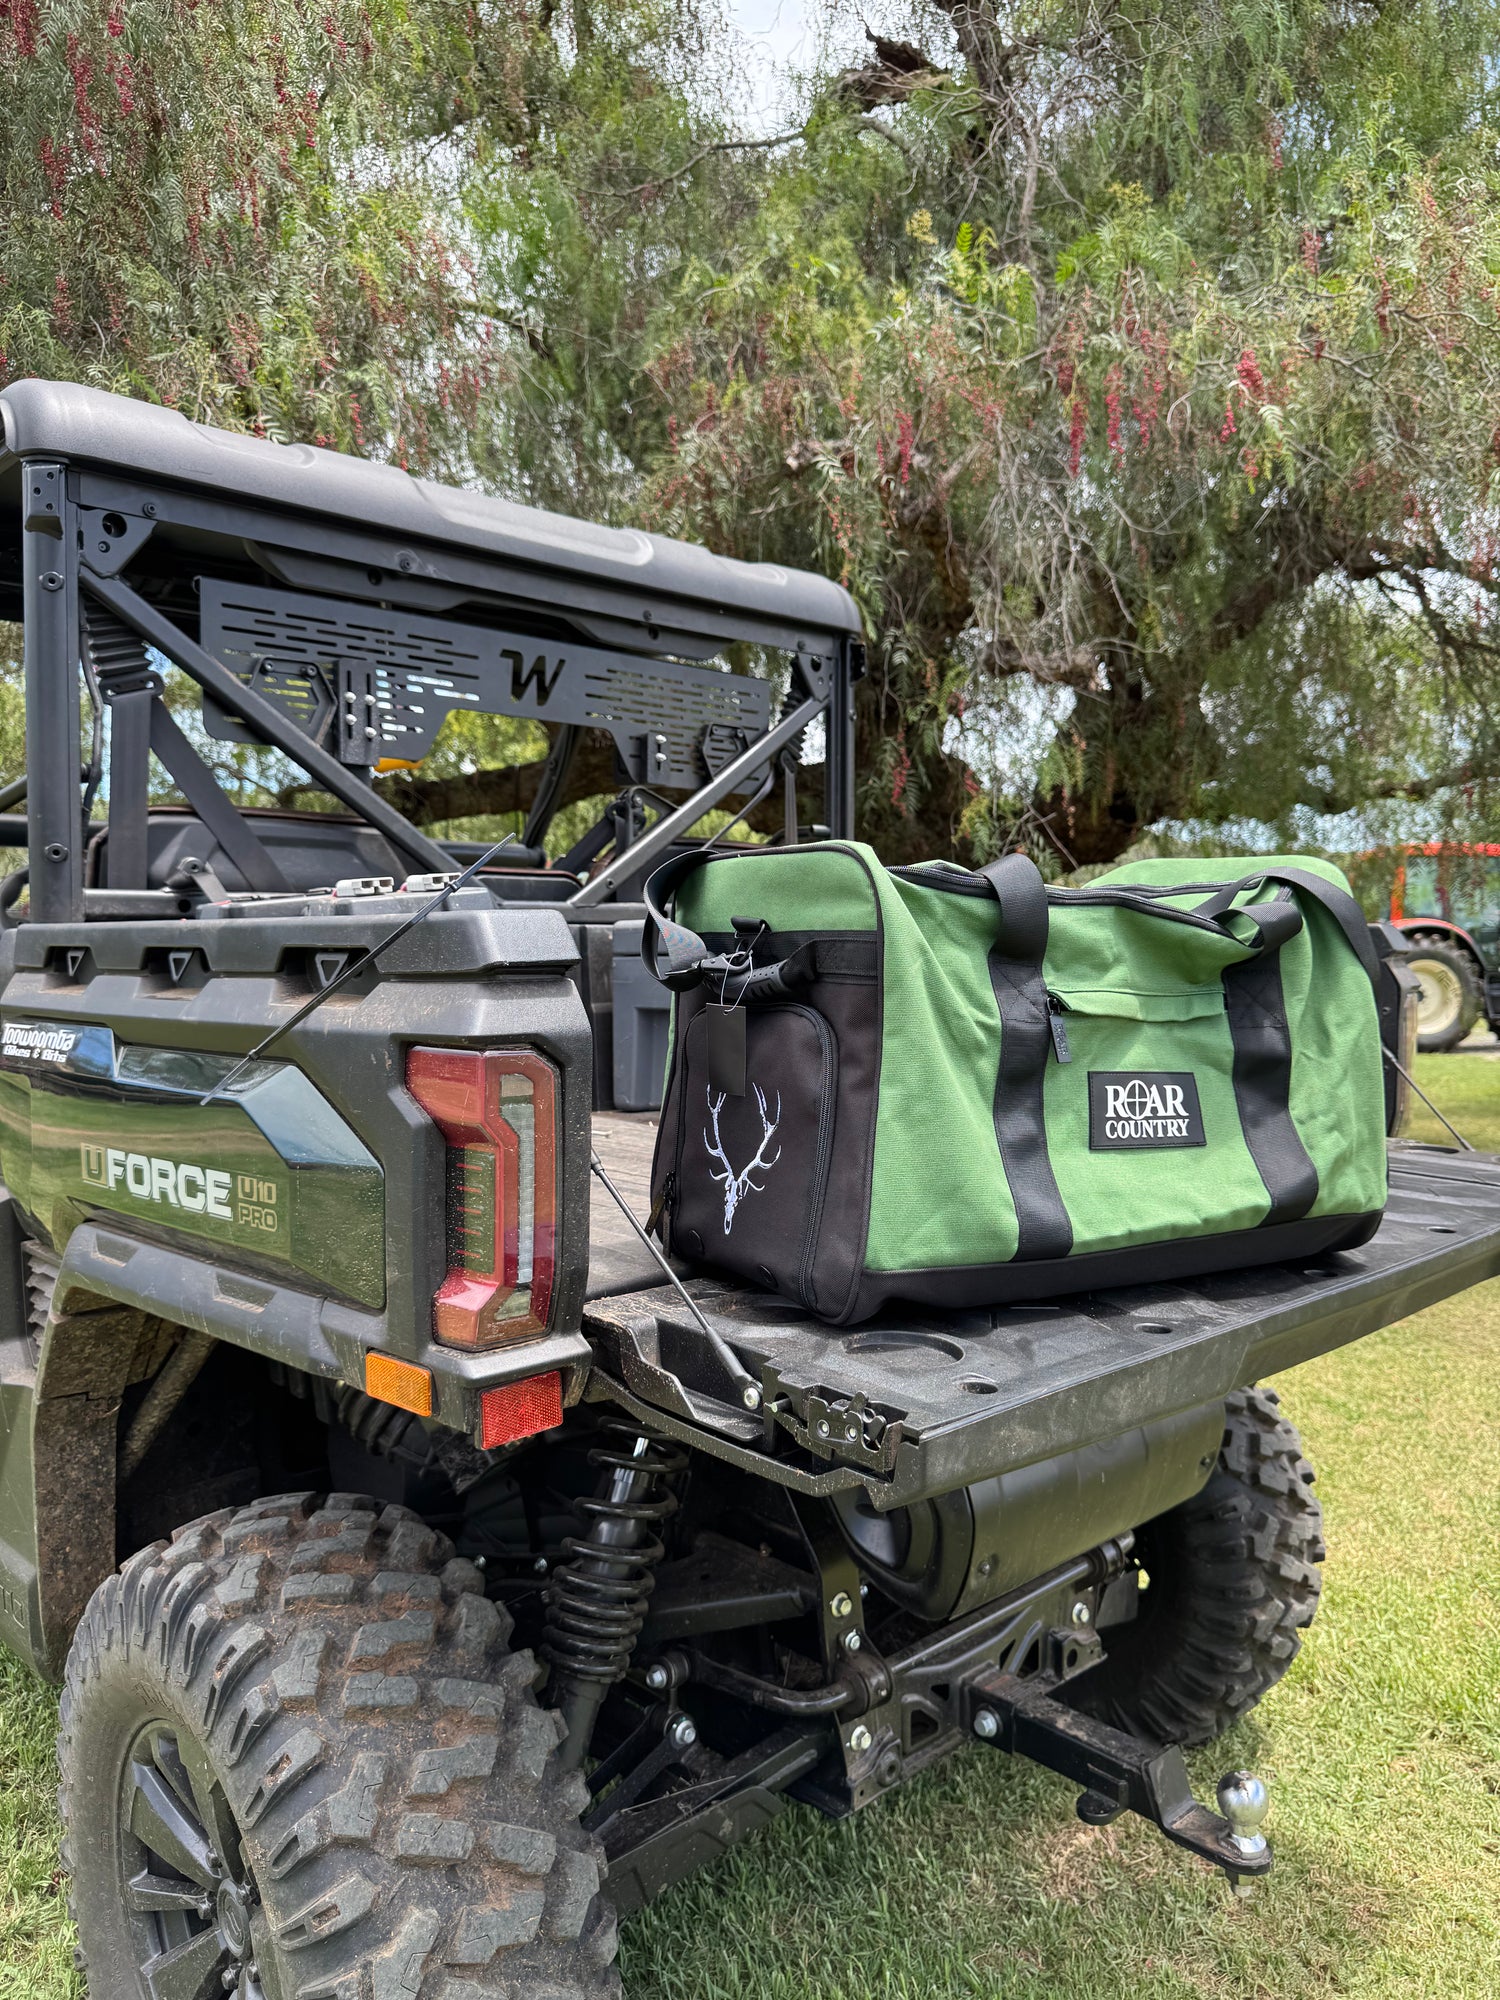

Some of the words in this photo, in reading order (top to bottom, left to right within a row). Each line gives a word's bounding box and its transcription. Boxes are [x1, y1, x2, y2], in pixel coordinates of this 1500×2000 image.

[2, 1023, 76, 1051] Toowoomba
[3, 1045, 31, 1058] Bikes
[32, 1048, 41, 1059] &
[1104, 1079, 1190, 1120] ROAR
[1104, 1119, 1190, 1139] COUNTRY
[237, 1175, 277, 1204] U10
[238, 1203, 278, 1232] PRO
